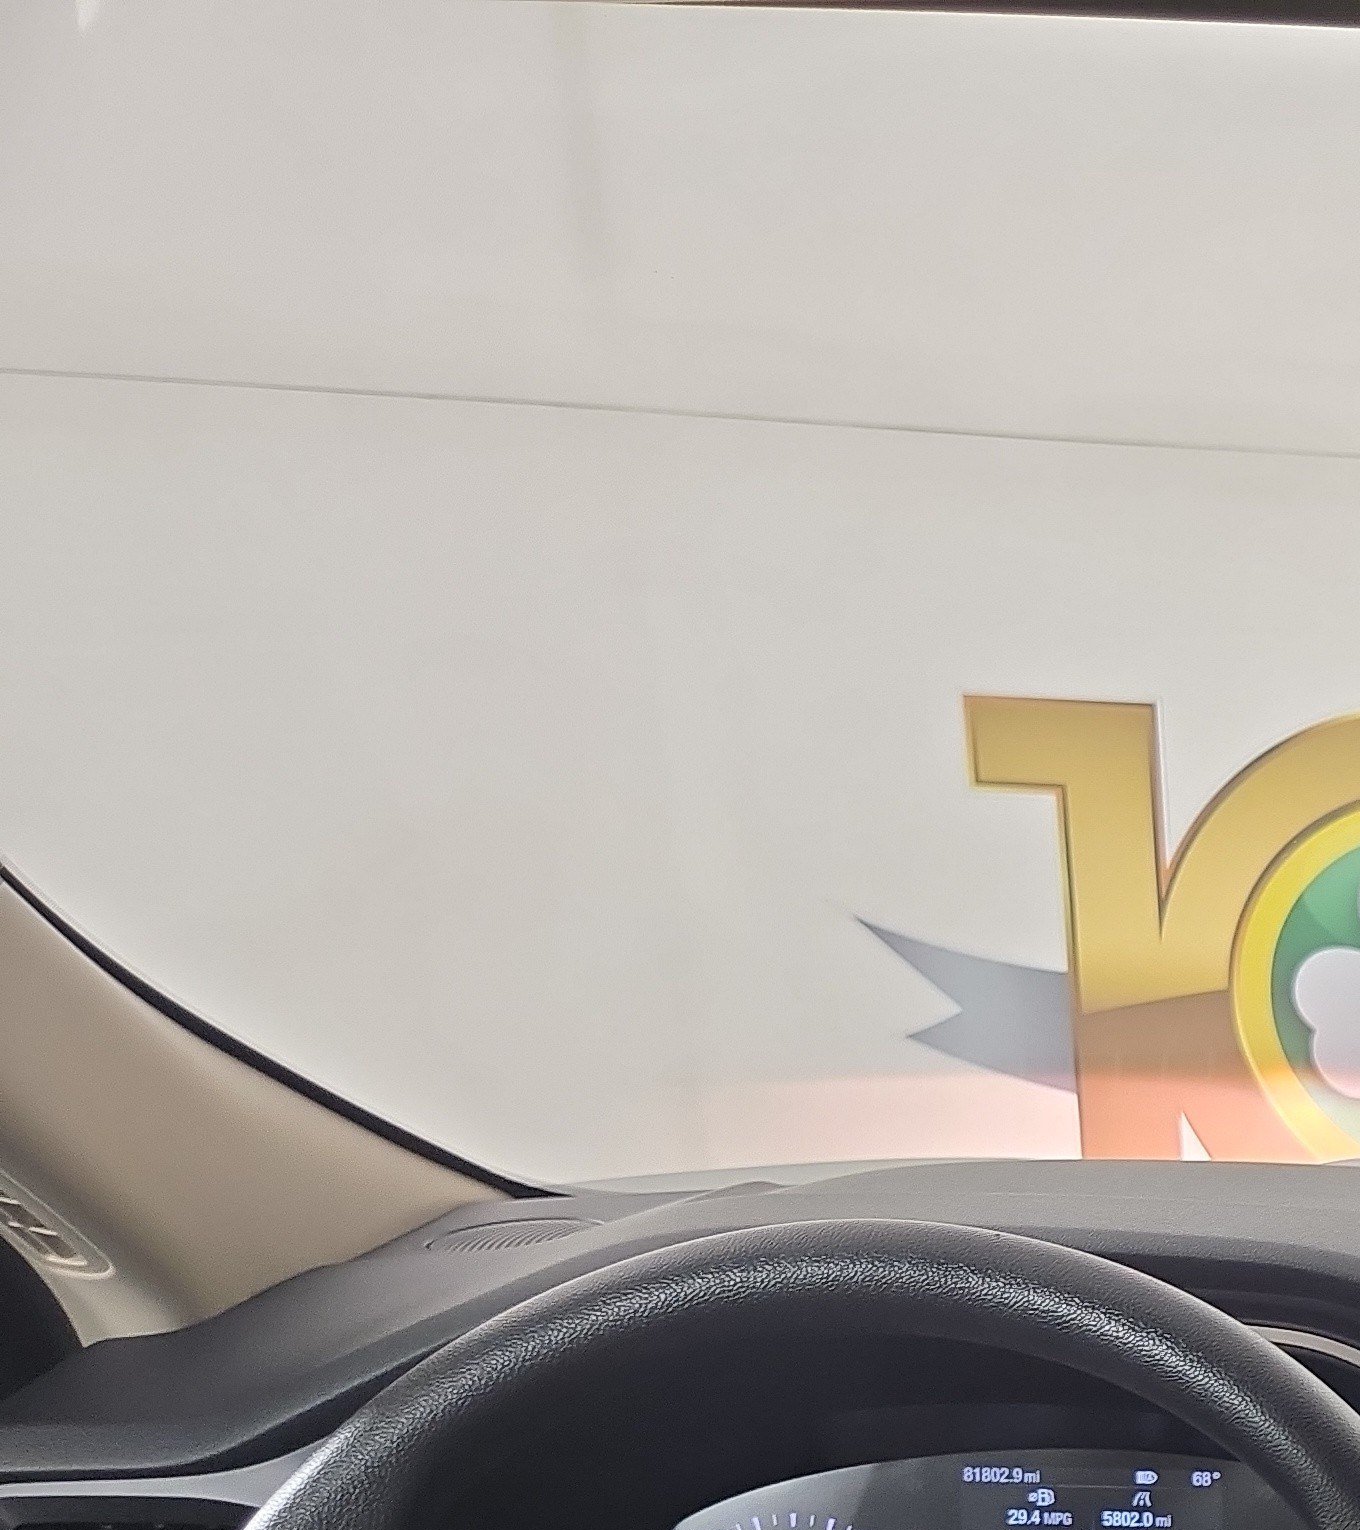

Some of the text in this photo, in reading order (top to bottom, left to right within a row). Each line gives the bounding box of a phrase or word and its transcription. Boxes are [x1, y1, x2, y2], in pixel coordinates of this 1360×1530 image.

[962, 1466, 1023, 1483] 81802.9
[1190, 1471, 1222, 1487] 68°
[1006, 1509, 1073, 1527] 29.4 MPG
[1101, 1510, 1173, 1528] 5802.0 mi
